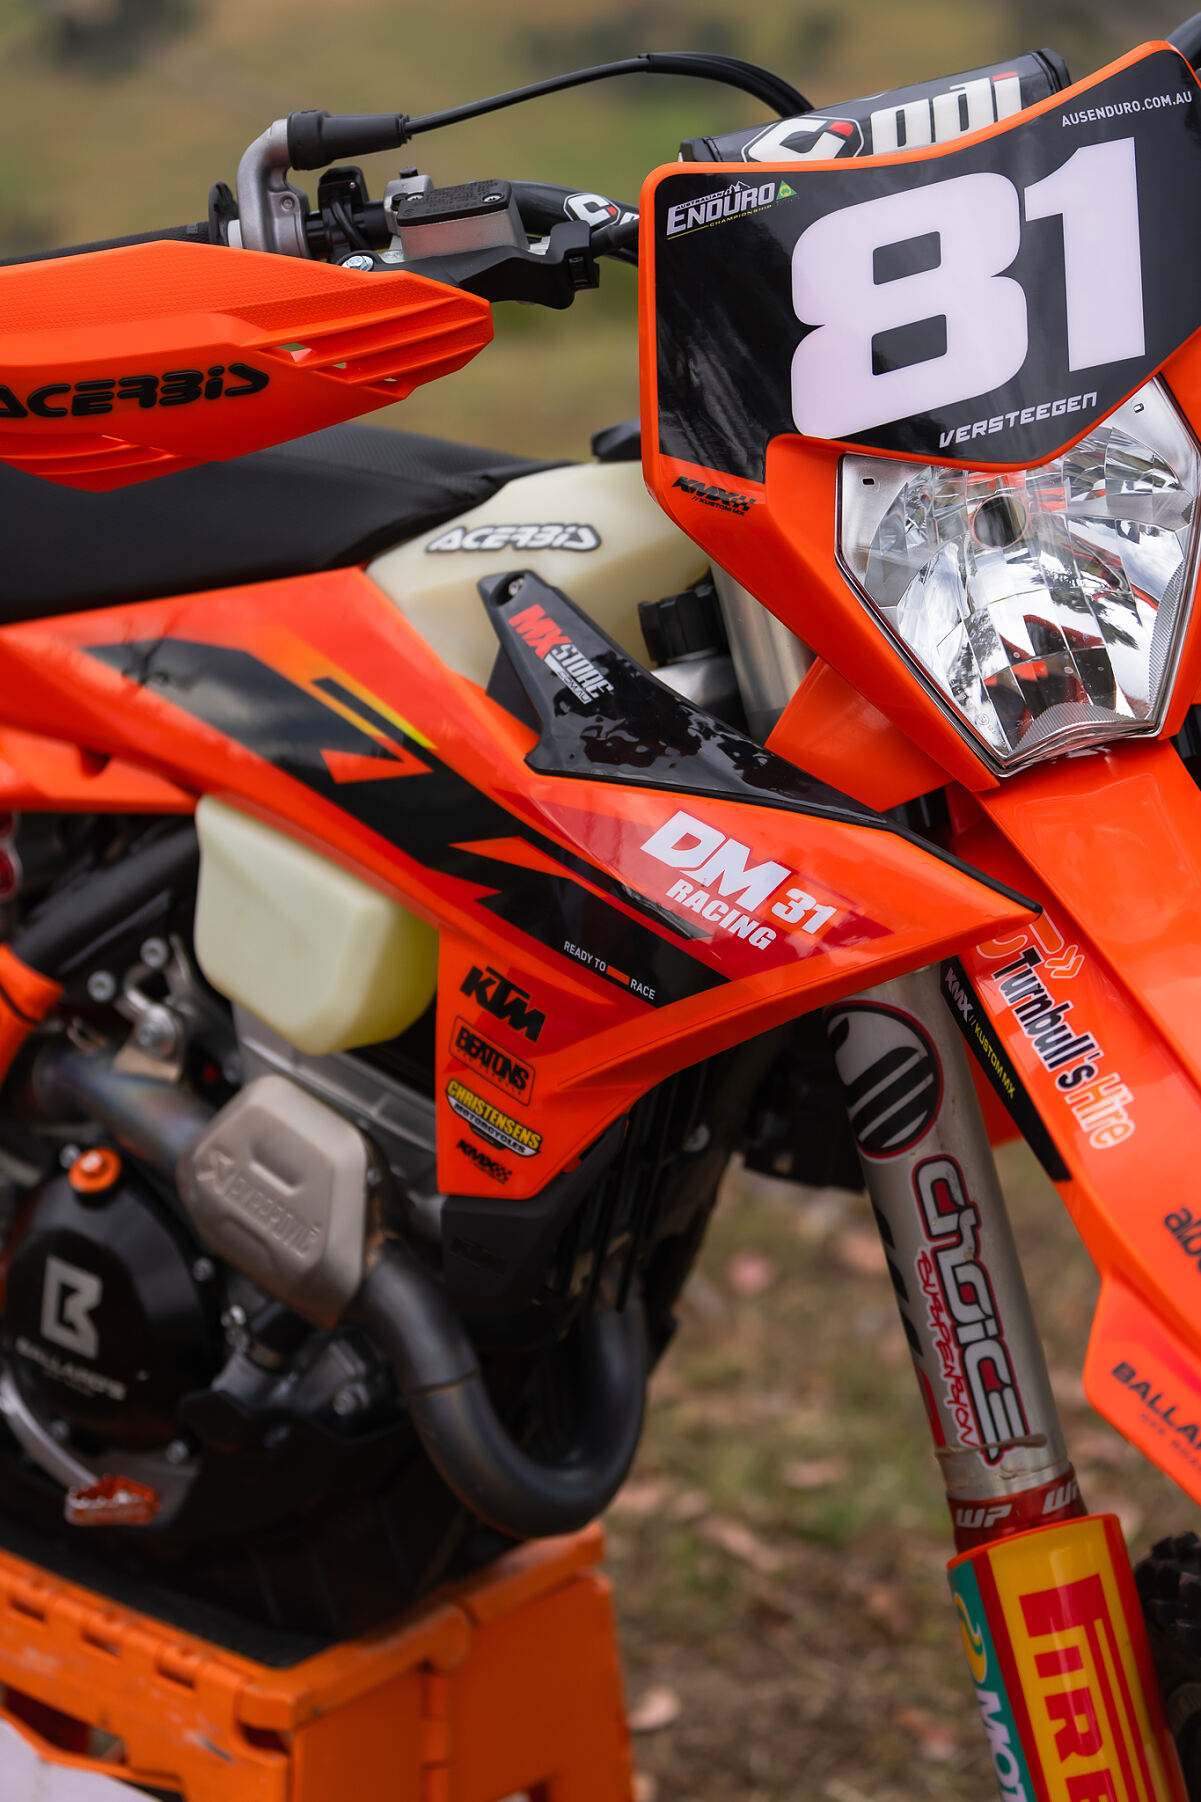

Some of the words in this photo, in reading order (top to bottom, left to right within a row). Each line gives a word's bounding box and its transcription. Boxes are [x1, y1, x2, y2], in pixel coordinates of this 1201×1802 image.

[1062, 91, 1193, 127] AUSENDURO.COM.AU
[666, 182, 776, 236] ENDURO
[709, 203, 773, 228] CHAMPIONSHIP
[791, 136, 1146, 440] 81
[939, 391, 1098, 449] VERSTEEGEN
[427, 523, 602, 553] ACERBIS
[640, 810, 792, 913] DM
[771, 888, 838, 935] 31
[665, 878, 778, 950] RACING
[563, 940, 594, 964] READY
[594, 957, 607, 972] TO
[630, 978, 656, 1000] RACE
[460, 965, 546, 1043] KTM
[945, 967, 974, 1023] KMX
[974, 1022, 1004, 1078] KUSTOM
[1002, 1071, 1016, 1100] MX
[455, 1026, 530, 1091] BEATONS
[992, 945, 1104, 1091] Turnbull's
[1064, 1072, 1135, 1149] Hire
[447, 1080, 541, 1150] CHRISTENSENS
[1111, 1361, 1201, 1450] BALLA
[956, 1503, 1013, 1529] WP
